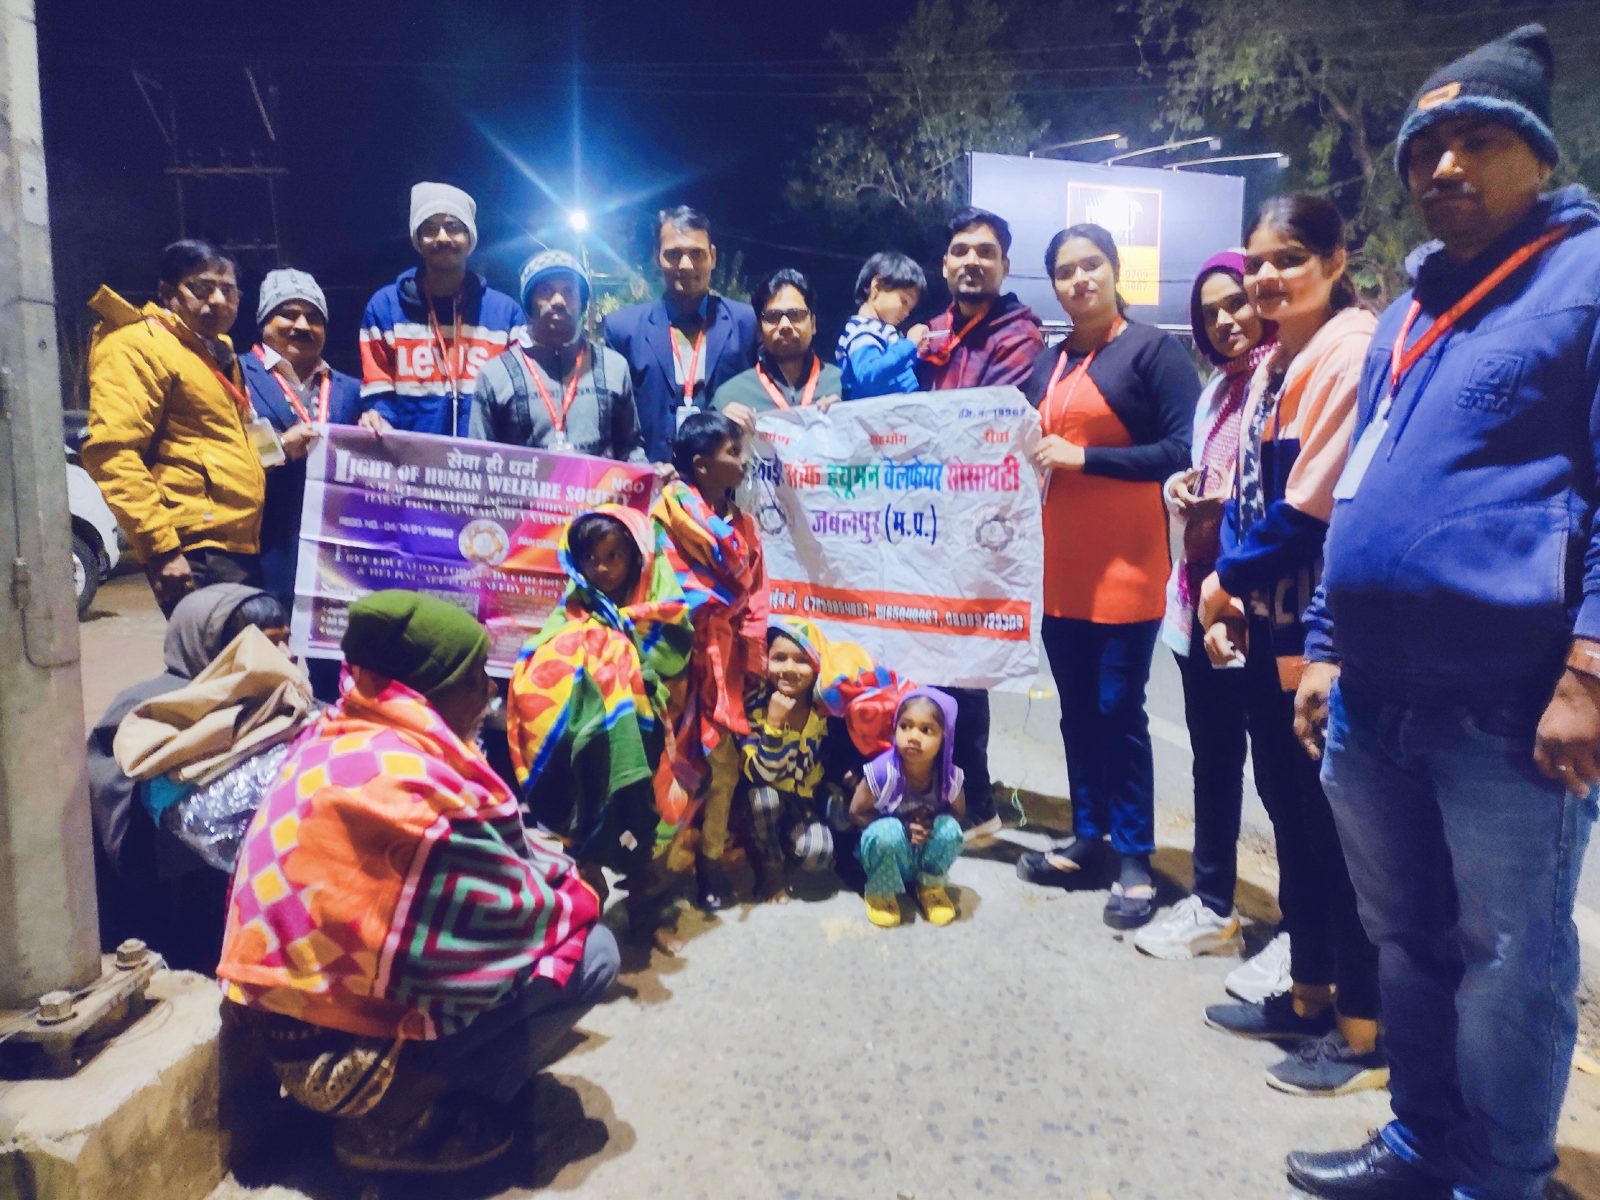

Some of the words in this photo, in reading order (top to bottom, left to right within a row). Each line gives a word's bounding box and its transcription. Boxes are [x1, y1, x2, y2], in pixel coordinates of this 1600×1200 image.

[397, 464, 420, 482] OF
[424, 466, 482, 490] HUMAN
[486, 474, 561, 500] WELFARE
[565, 484, 632, 507] SOCIETY
[611, 477, 645, 494] NGO
[811, 509, 881, 544] जबलपुर
